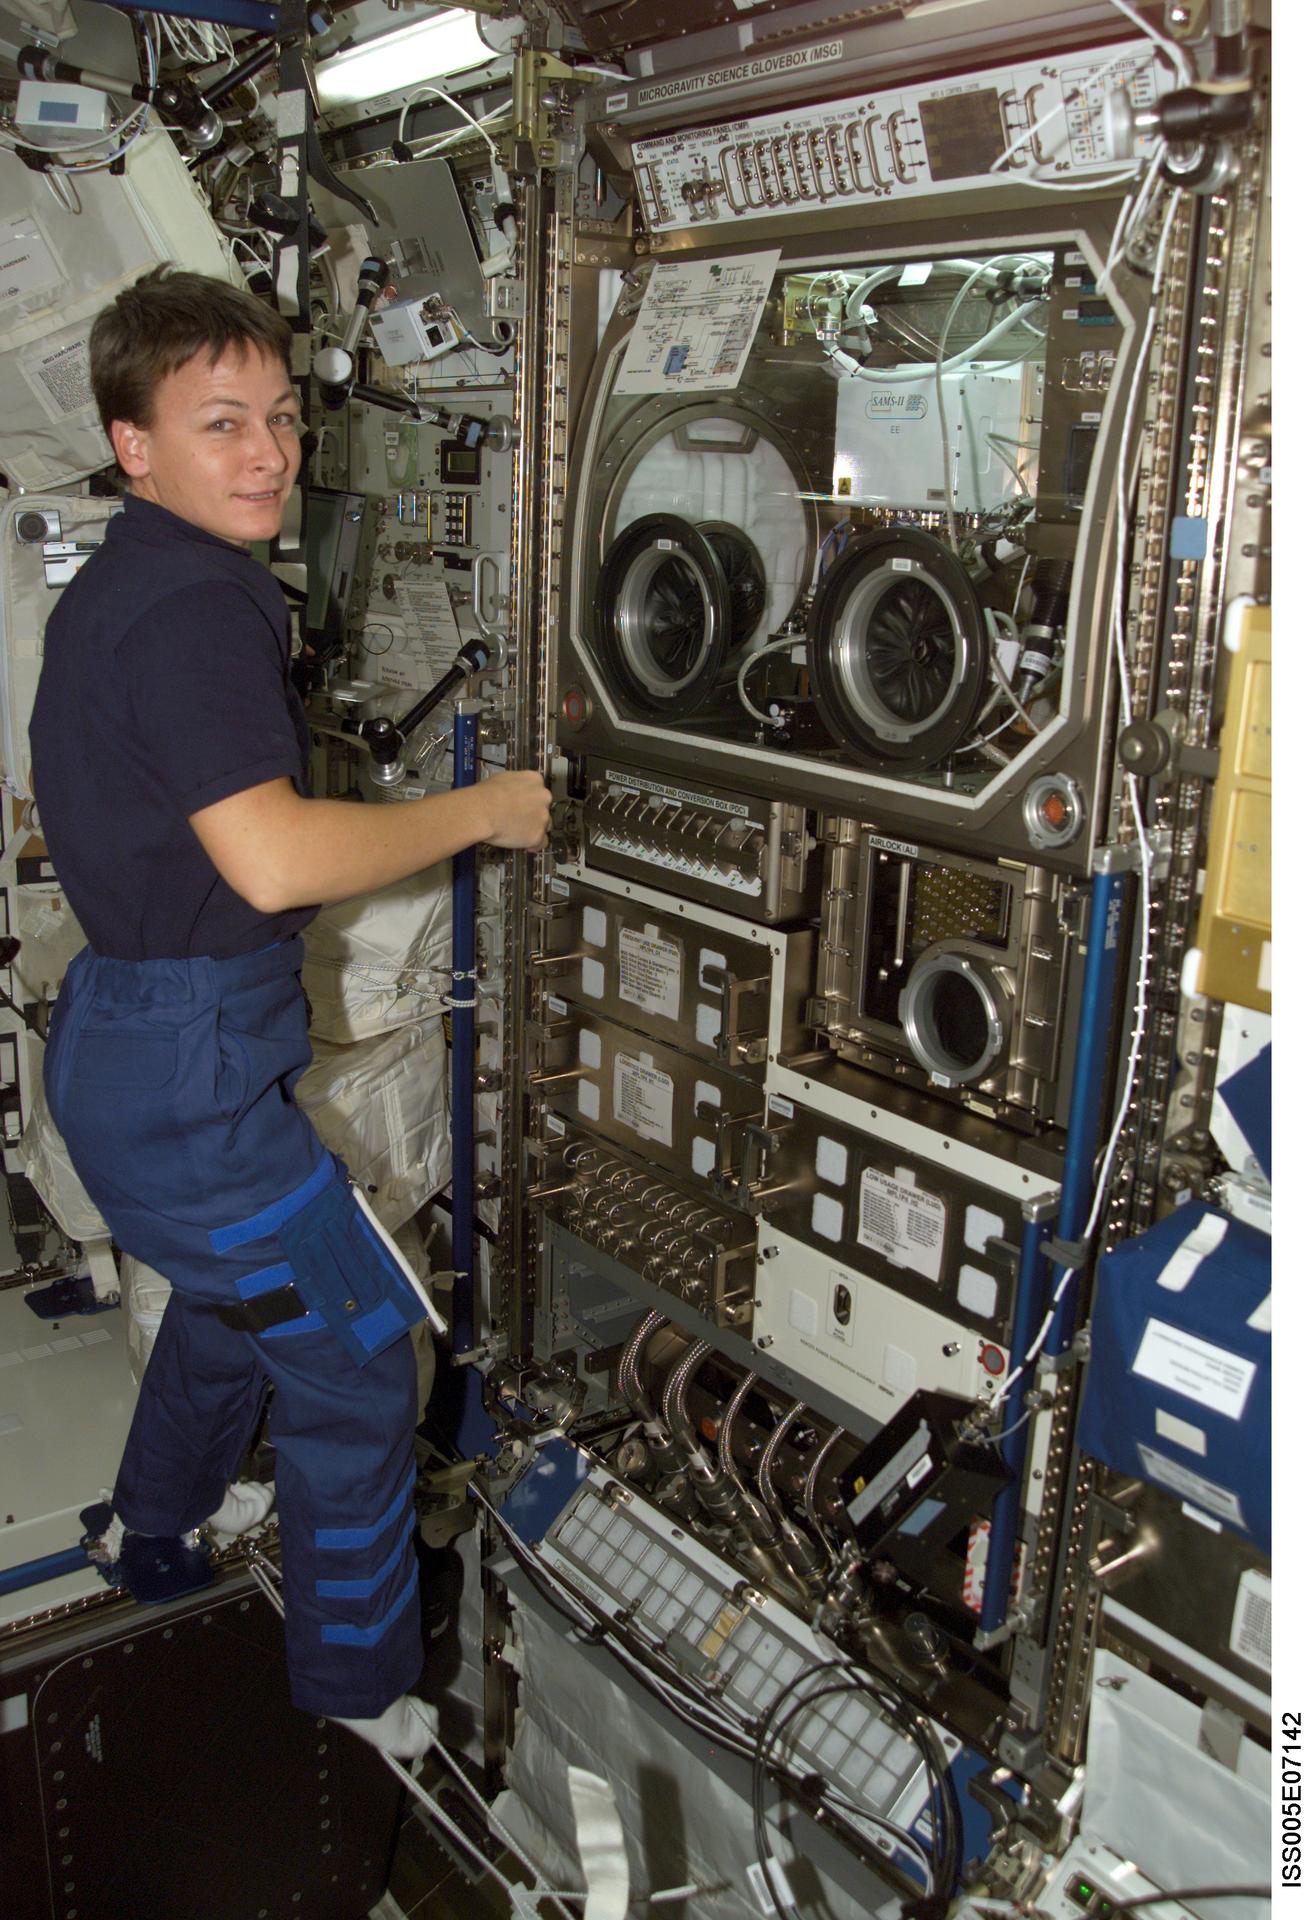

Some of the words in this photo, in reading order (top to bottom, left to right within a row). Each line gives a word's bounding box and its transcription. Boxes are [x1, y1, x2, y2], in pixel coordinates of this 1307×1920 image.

[639, 77, 705, 103] MICROGRAVITY
[707, 67, 749, 86] SCIENCE
[751, 50, 807, 77] GLOVEBOX
[810, 43, 842, 62] (MSG)
[637, 138, 665, 150] COMMAND
[665, 136, 677, 146] AND
[678, 129, 712, 144] MONITORING
[713, 124, 731, 136] PANEL
[872, 396, 905, 407] SAMS-II
[890, 425, 901, 434] EE
[608, 773, 627, 783] POWER
[628, 777, 664, 793] DISTRIBUTION
[665, 788, 677, 796] AND
[677, 790, 714, 807] CONVERSION
[715, 800, 728, 810] BOX
[729, 803, 746, 815] (PDC)
[870, 836, 902, 852] AIRLOCK
[902, 845, 917, 856] (AL)
[865, 1171, 879, 1182] LOW
[880, 1177, 898, 1192] USAGE
[899, 1186, 925, 1202] DRAWER
